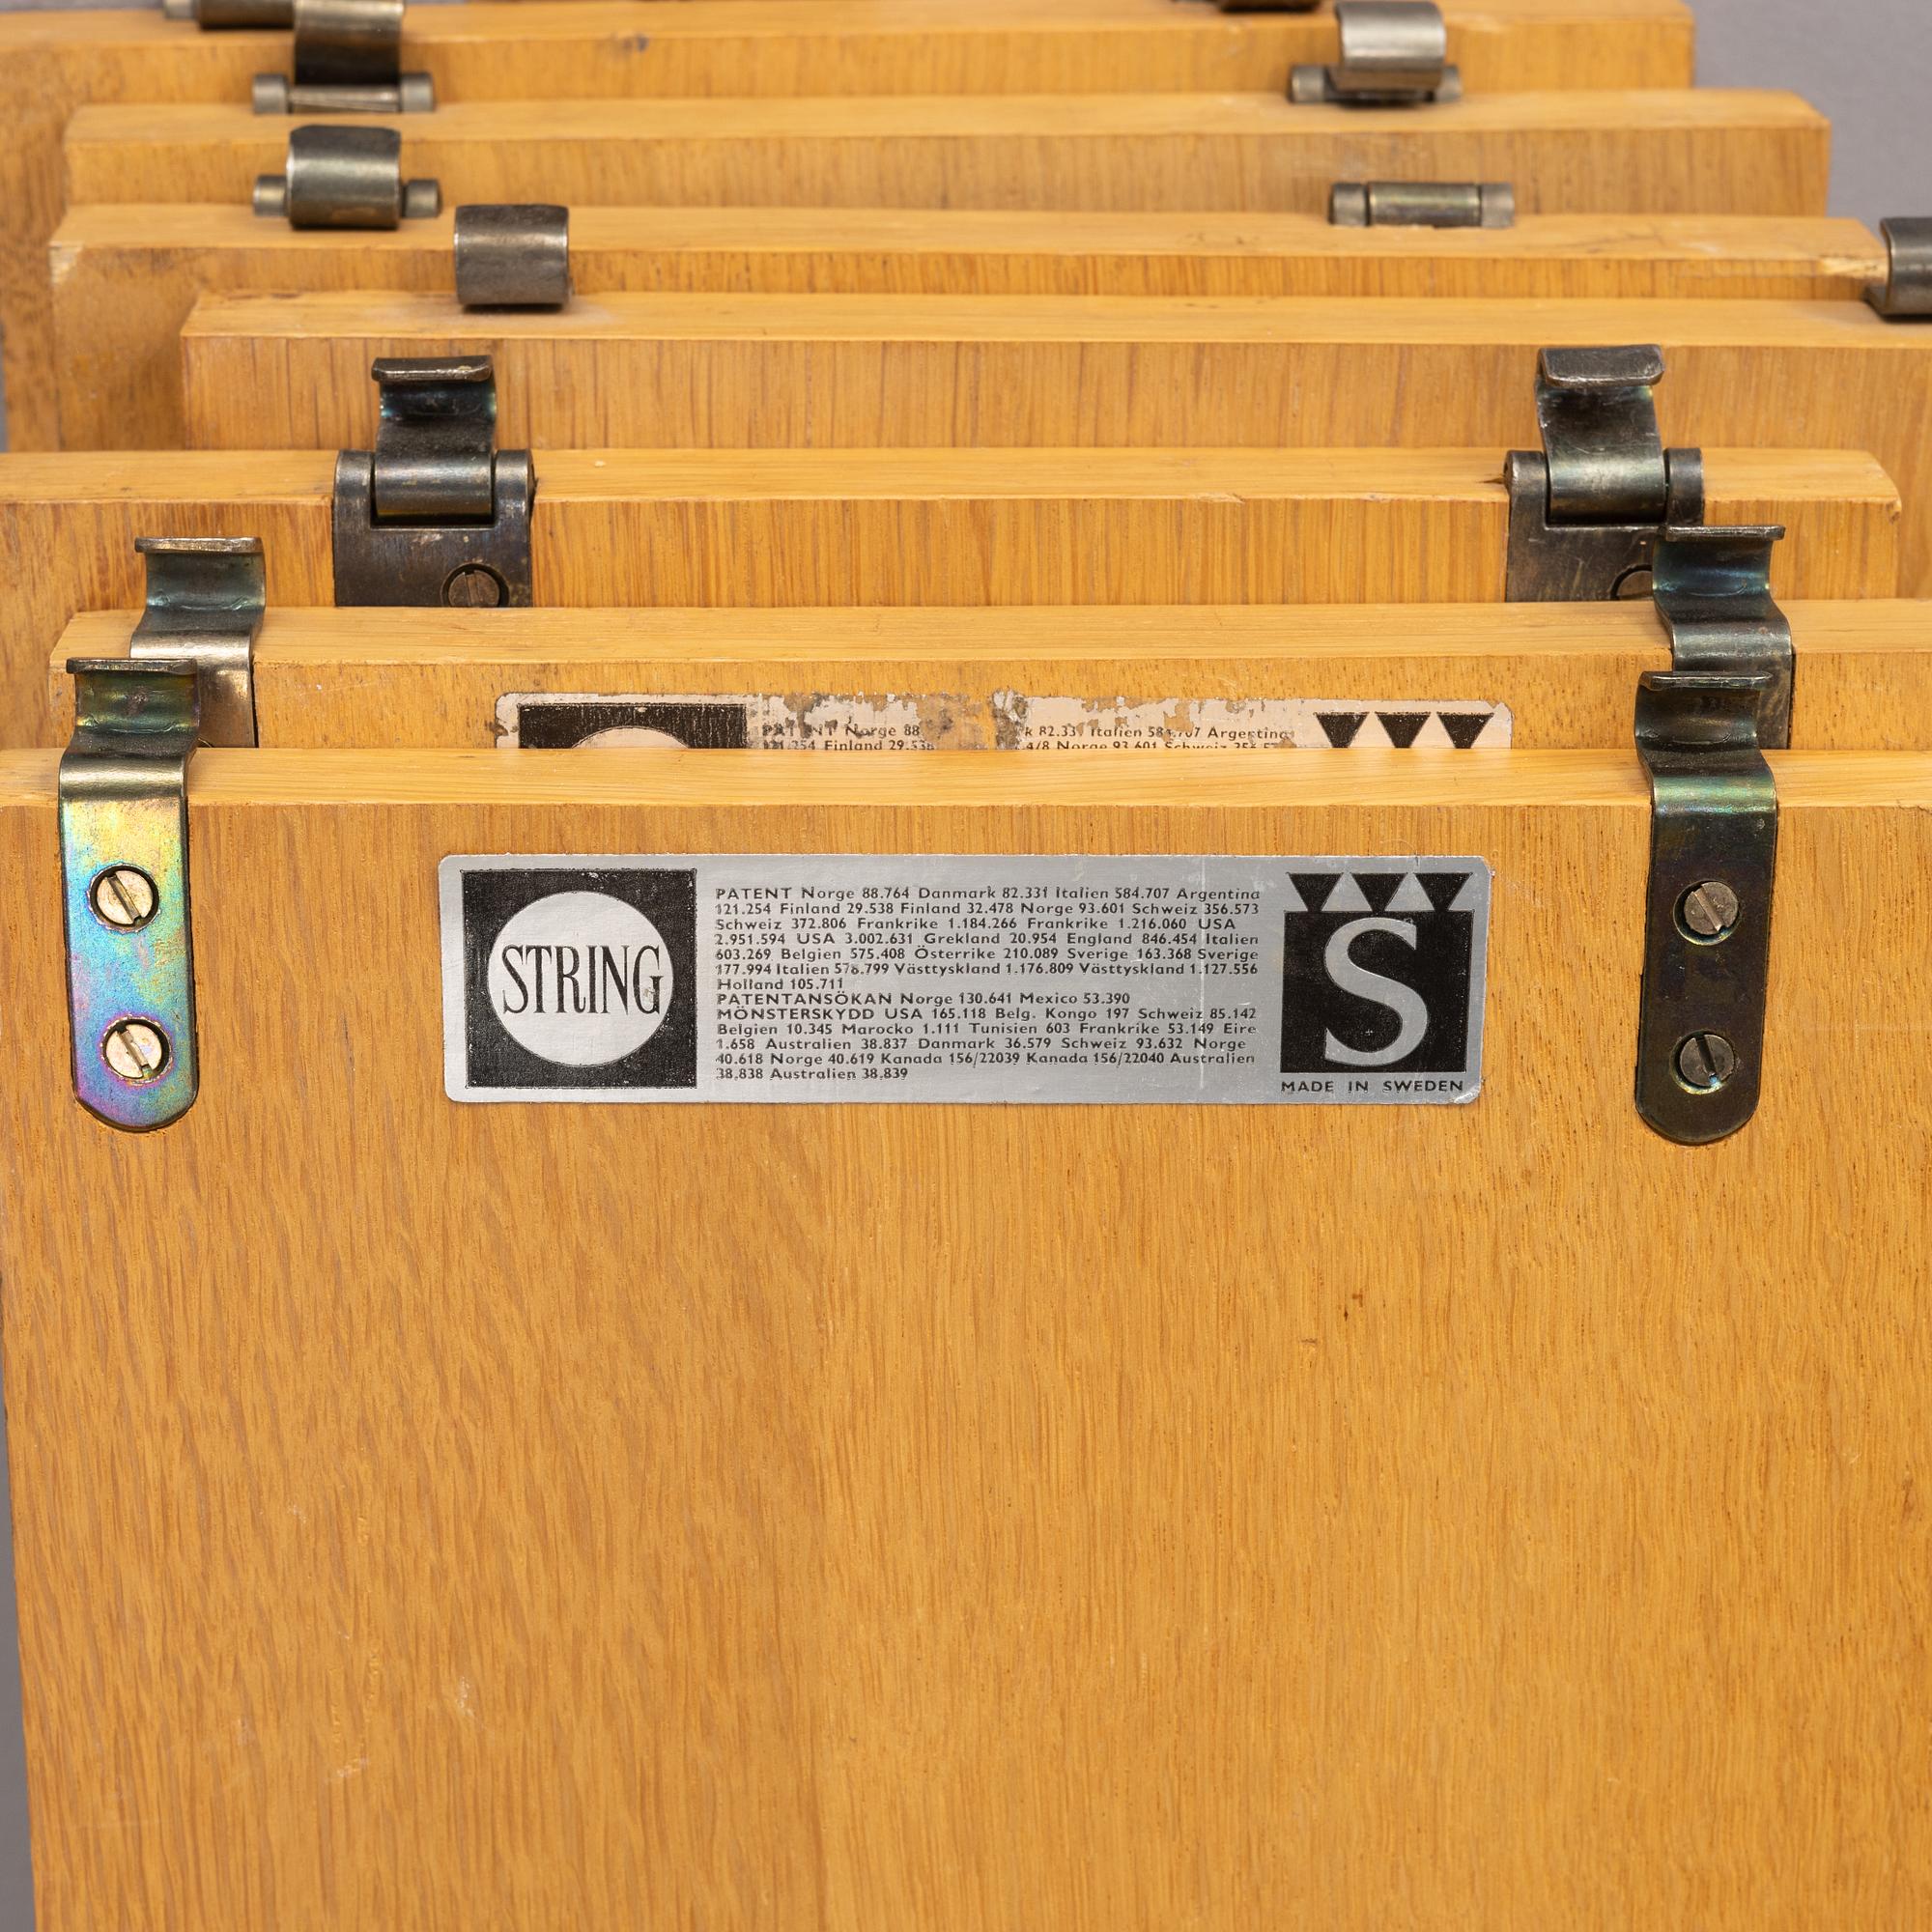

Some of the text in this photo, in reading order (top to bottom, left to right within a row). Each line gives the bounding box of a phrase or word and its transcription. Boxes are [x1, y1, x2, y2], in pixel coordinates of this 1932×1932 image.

[762, 723, 838, 736] PATNT
[824, 740, 883, 751] Finland
[716, 886, 1260, 901] PATENT Norge 88.764 Danmark 82.331 Italien 584.707 Argentina
[715, 901, 1259, 917] 121.254 Finland 29.538 Finland 32.478 Norge 93.601 Schweiz 356.573
[716, 917, 1236, 930] Schweiz 372.806 Frankrike 1.184.266 Frankrike 1.216.060 USA
[714, 932, 1258, 948] 2.951.594 USA 3.002.631 Grekland 20.954 England 846.454 Italien
[715, 944, 1258, 962] 603.269 Belgien 575.408 Österrike 210.089 Sverige 163.368 Sverige
[716, 962, 771, 975] 177.994
[777, 962, 829, 975] Italien
[895, 962, 1000, 978] Västtyskland
[1007, 962, 1073, 975] 1.176.809
[1079, 962, 1183, 978] Västtyskland
[1191, 962, 1258, 975] 1.127.556
[501, 943, 664, 1014] STRING
[718, 977, 842, 990] Holland 105.711
[717, 989, 1130, 1008] PATENTANSÖKAN Norge 130.641 Mexico 53.390
[717, 1004, 1256, 1022] MÖNSTERSKYDD USA 165.118 Belg. Kongo 197 Schweiz 85.142
[718, 1022, 1256, 1037] Belgien 10.345 Marocko 1.111 Tunisien 603 Frankrike 53.149 Eire
[717, 1037, 1245, 1053] 1.658 Australien 38.837 Danmark 36.579 Schweiz 93.632 Norge
[716, 1052, 1254, 1067] 40.618 Norge 40.619 Kanada 156/22039 Kanada 156/22040 Australien
[717, 1067, 908, 1080] 38.838 Australien 38.839
[1281, 1080, 1464, 1093] MADE IN SWEDEN
